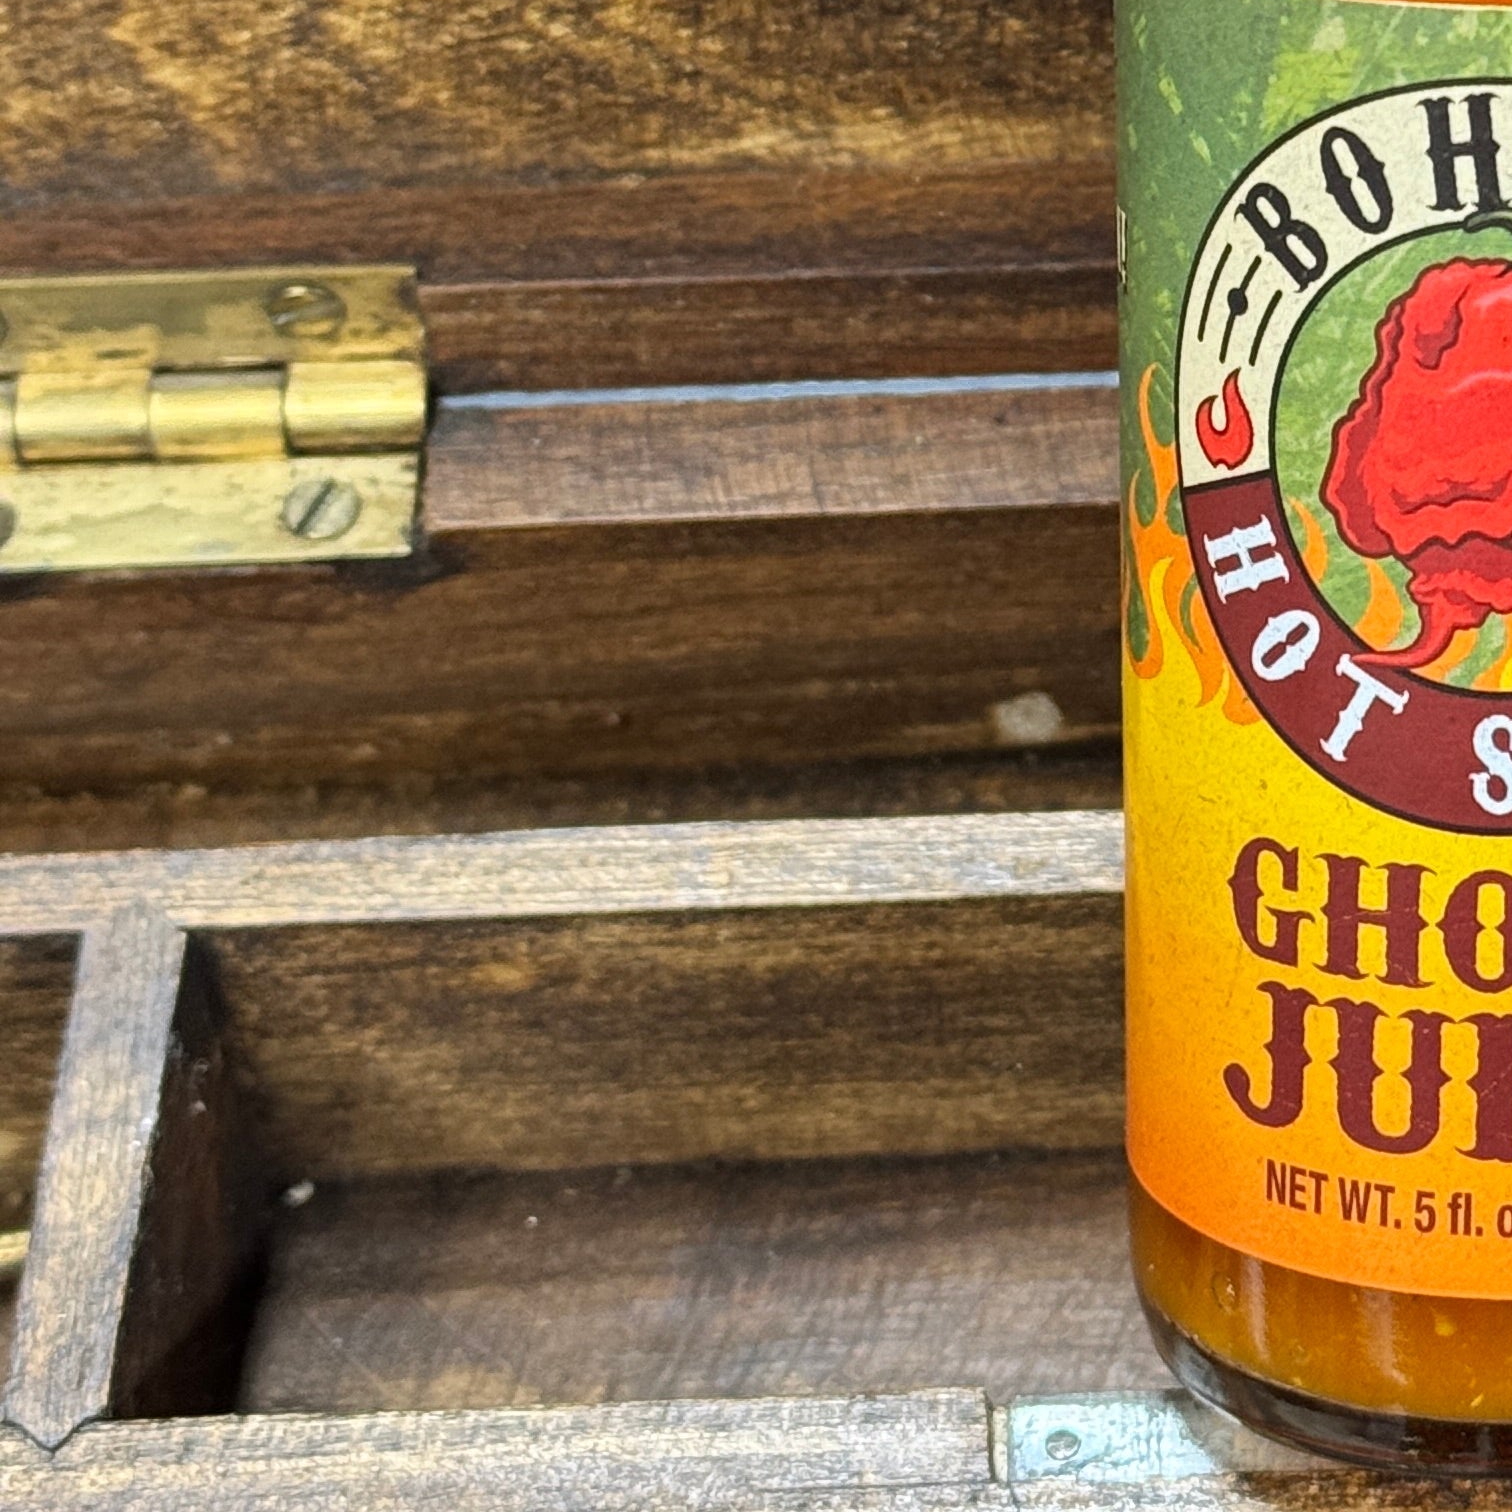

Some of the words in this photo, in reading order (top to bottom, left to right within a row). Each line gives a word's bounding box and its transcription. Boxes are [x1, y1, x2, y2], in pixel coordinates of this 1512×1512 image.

[1203, 513, 1410, 762] HOT
[1265, 1157, 1330, 1216] NET
[1337, 1176, 1403, 1234] WT.
[1413, 1189, 1437, 1234] 5
[1446, 1191, 1484, 1240] fl.
